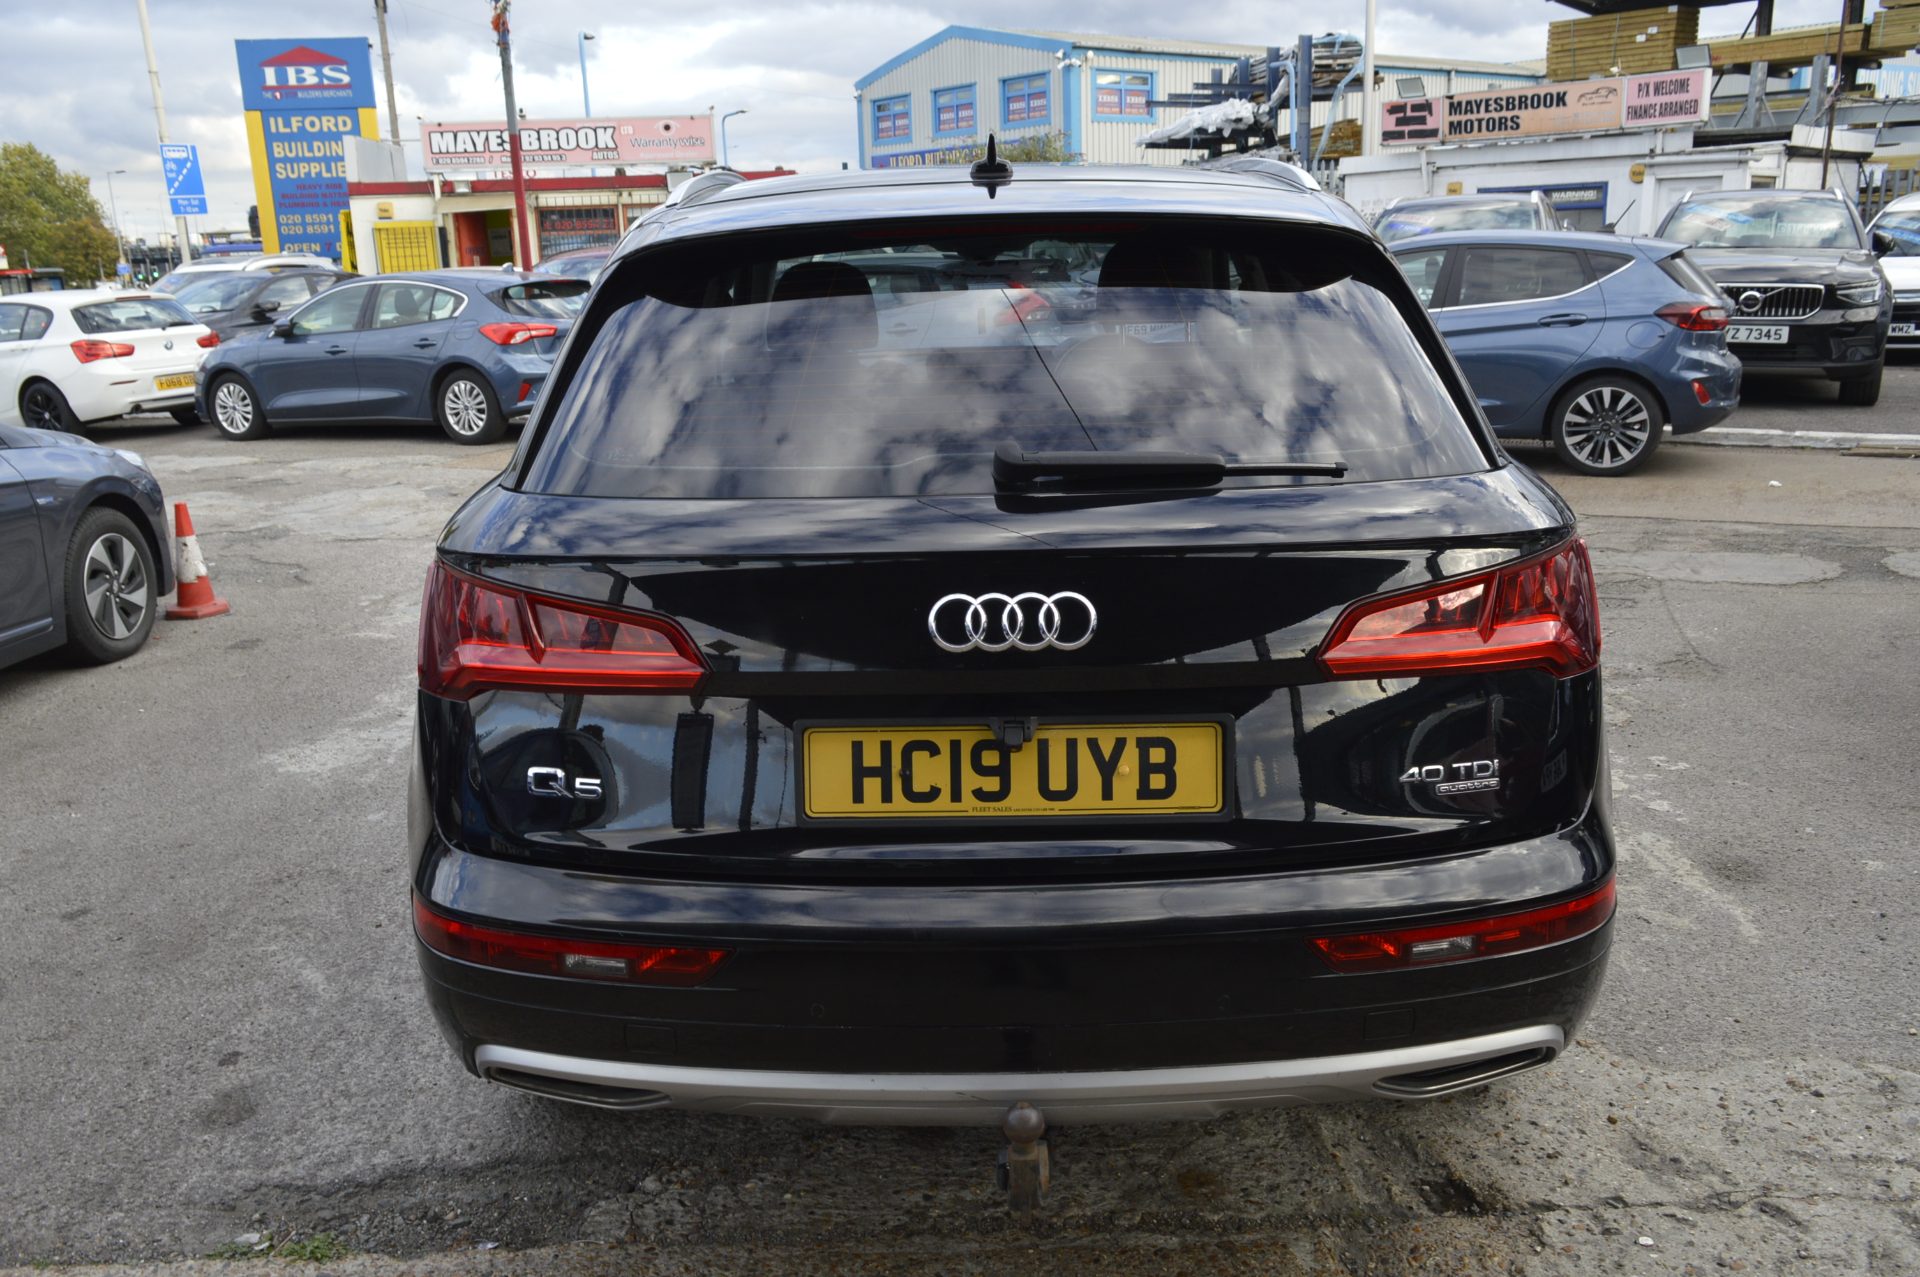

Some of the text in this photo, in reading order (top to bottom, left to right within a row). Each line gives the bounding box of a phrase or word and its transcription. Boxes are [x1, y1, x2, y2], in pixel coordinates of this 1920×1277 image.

[263, 65, 352, 87] IBS
[1637, 78, 1691, 99] P/X WELCOME
[1448, 91, 1568, 116] MAYESBROOK
[1626, 99, 1699, 121] FINANCE ARRANGED
[269, 115, 353, 133] ILFORD
[1448, 115, 1521, 136] MOTORS
[592, 149, 619, 161] AUTOS
[1551, 189, 1598, 199] WARNING!
[279, 213, 334, 224] 020 8591
[280, 224, 336, 235] 020 8591
[284, 242, 322, 253] OPEN
[1744, 327, 1783, 341] 7345
[851, 736, 1177, 804] HC19 UYB
[1399, 759, 1499, 784] 40 TDI
[527, 766, 602, 799] Q5
[1439, 780, 1498, 792] quattro
